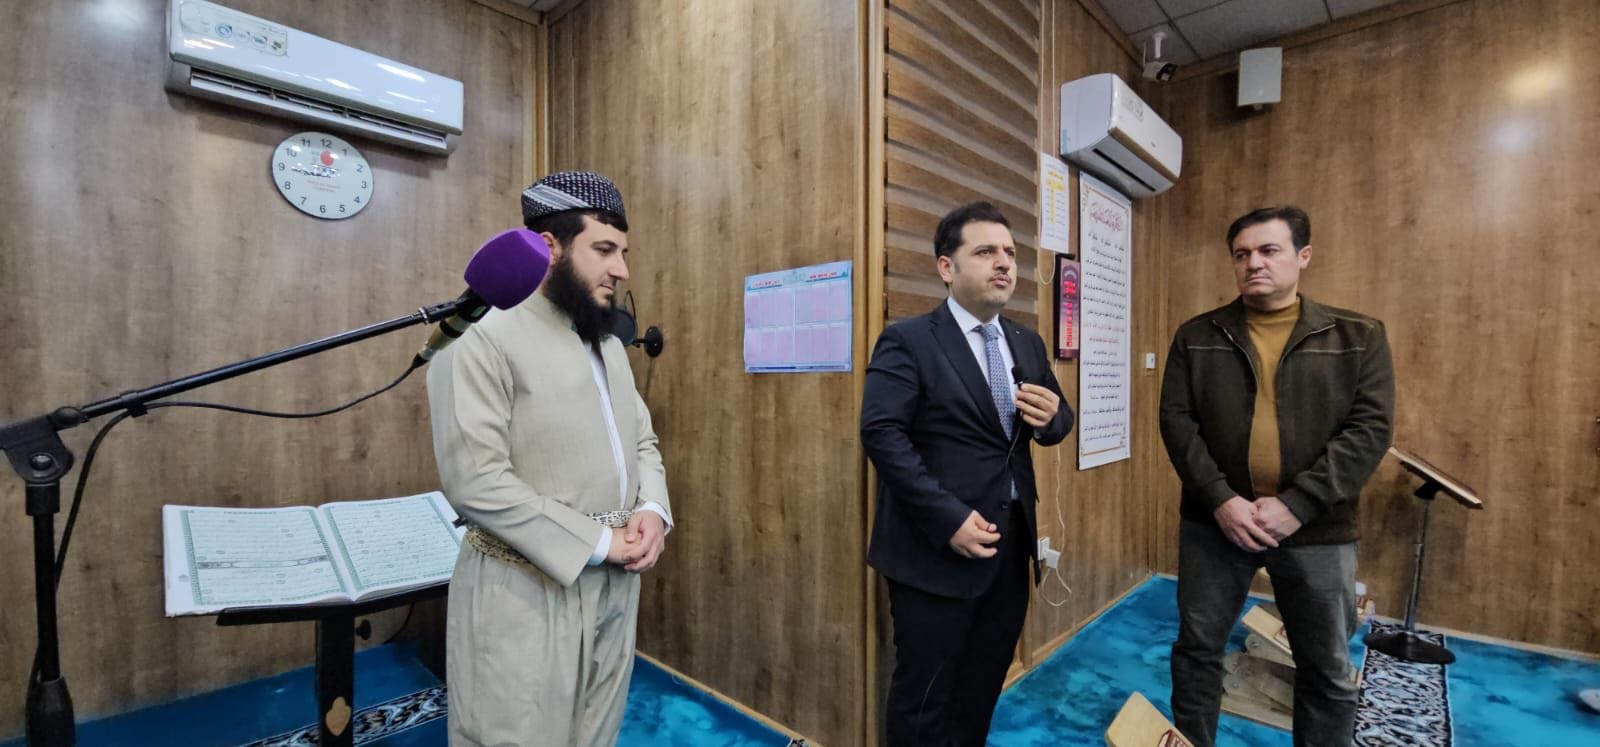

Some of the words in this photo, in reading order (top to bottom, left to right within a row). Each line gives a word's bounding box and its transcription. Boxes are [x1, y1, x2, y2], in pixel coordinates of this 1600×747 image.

[301, 139, 311, 147] 11
[320, 139, 332, 148] 12
[278, 162, 285, 171] 9
[356, 164, 363, 173] 2
[284, 181, 291, 190] 8
[361, 181, 367, 189] 3
[300, 197, 307, 205] 7
[353, 196, 360, 204] 4
[319, 205, 326, 213] 6
[339, 204, 345, 213] 5
